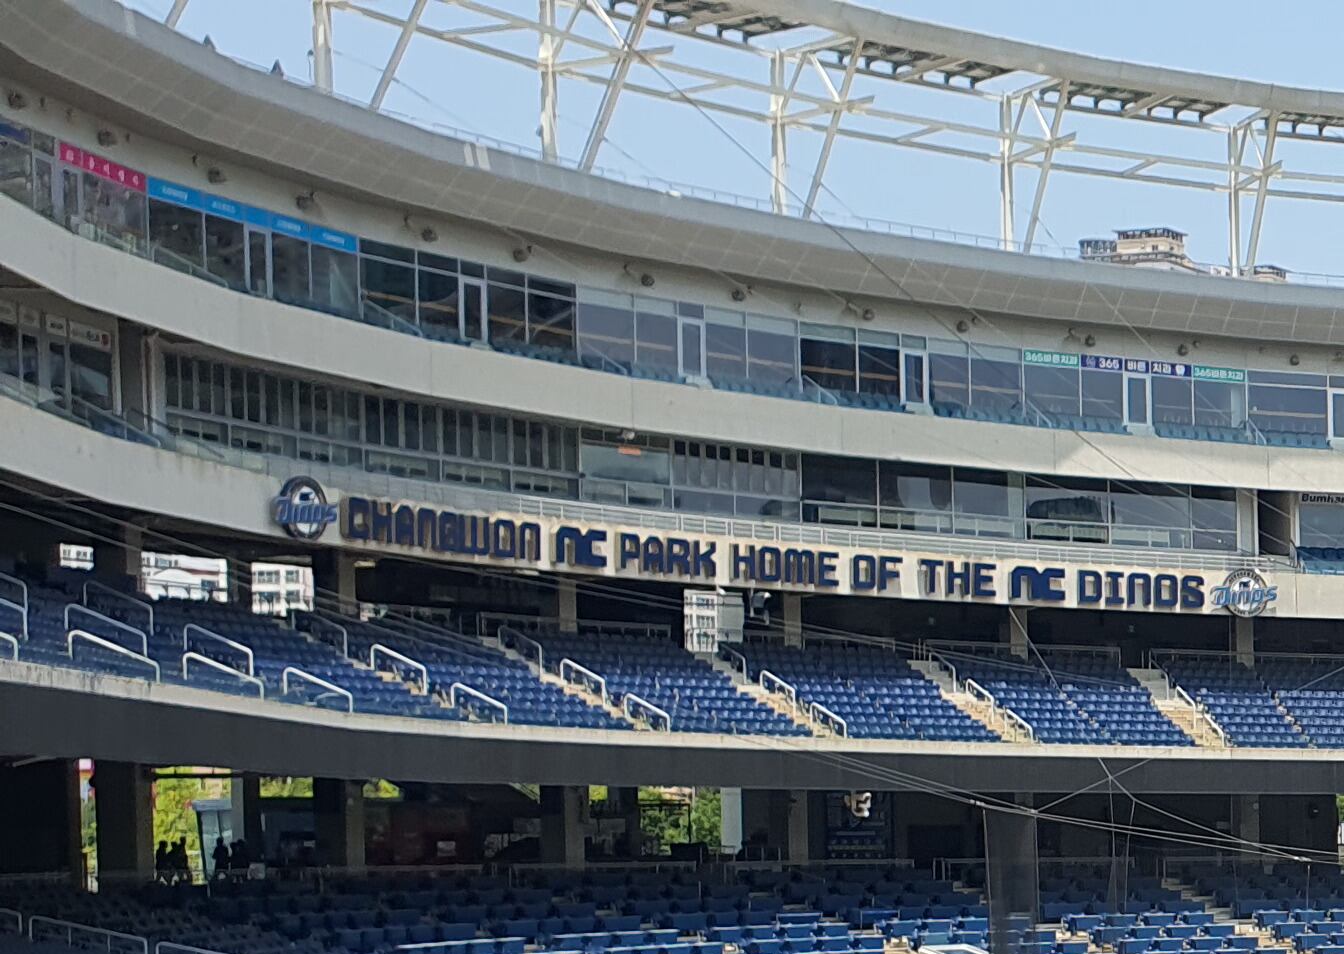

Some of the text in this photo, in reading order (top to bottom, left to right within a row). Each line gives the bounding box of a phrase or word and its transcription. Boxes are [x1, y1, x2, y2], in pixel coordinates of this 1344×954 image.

[1099, 358, 1120, 369] 365
[347, 497, 541, 560] CHANGWON
[620, 532, 717, 577] PARK
[733, 543, 839, 587] HOME
[852, 554, 902, 591] OF
[919, 559, 997, 597] THE
[1079, 569, 1205, 608] DINOS
